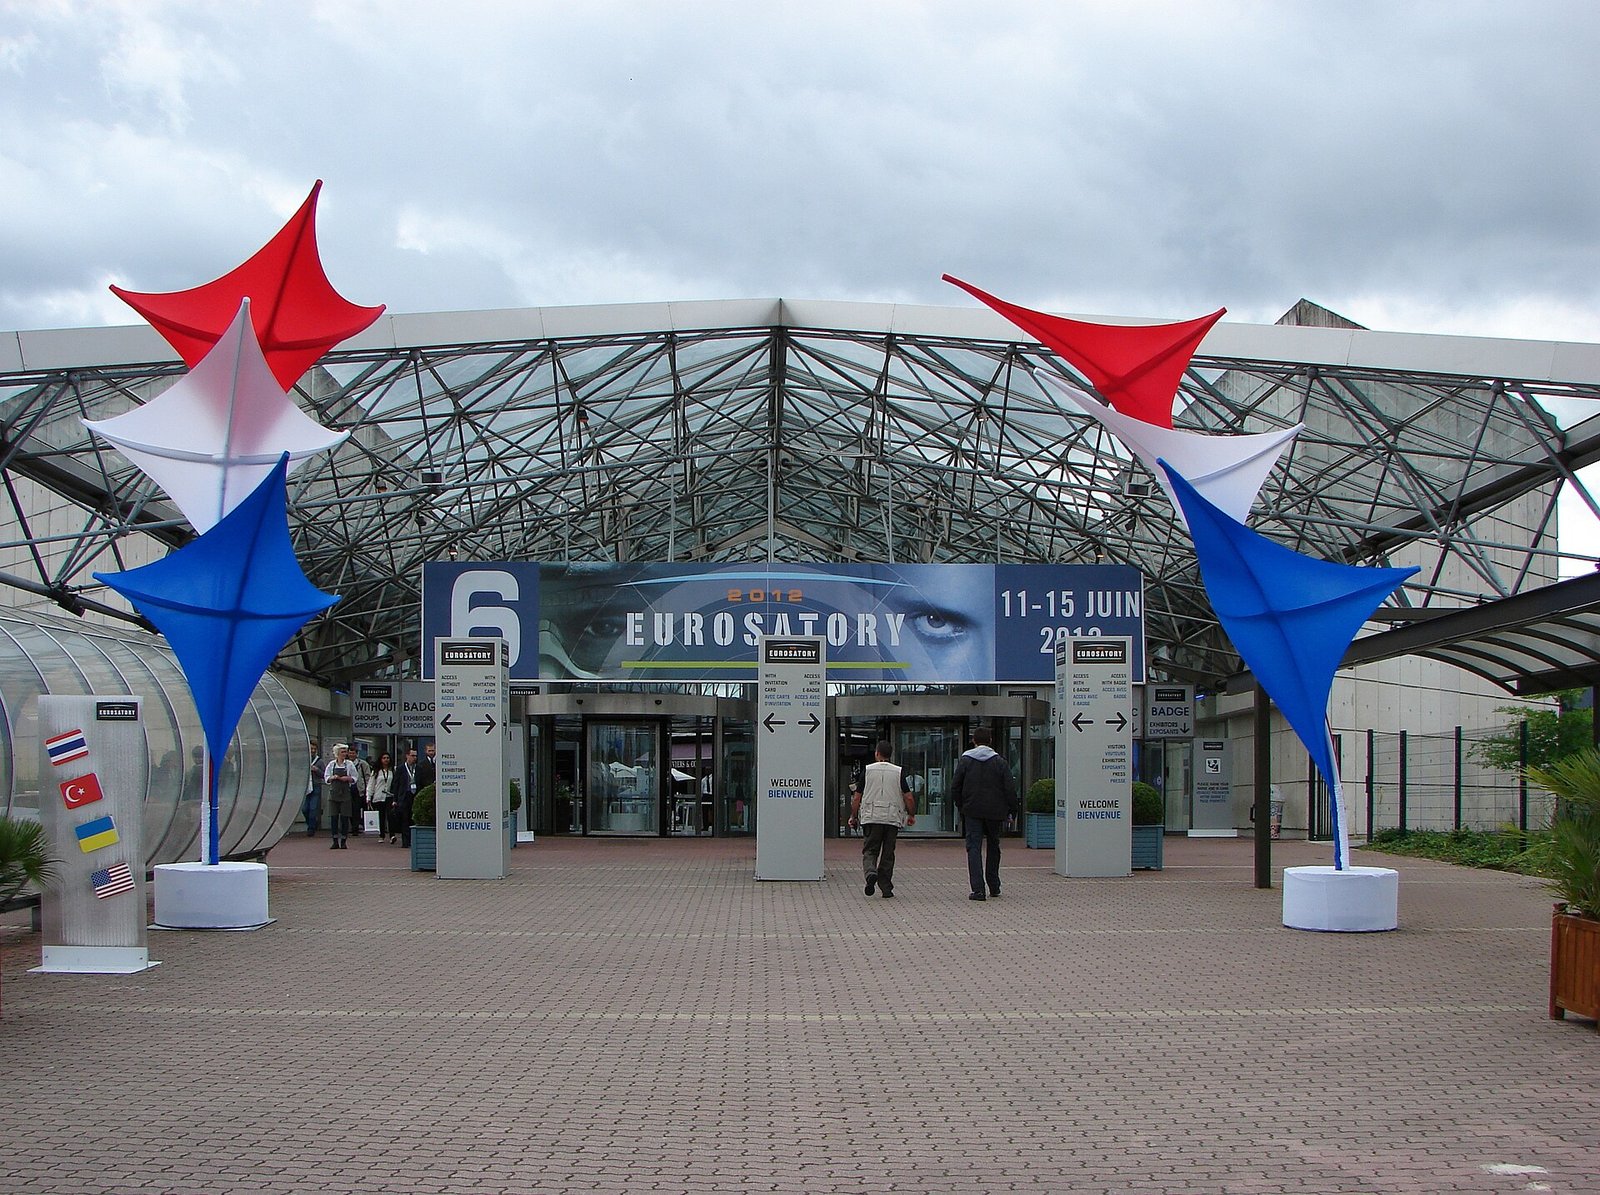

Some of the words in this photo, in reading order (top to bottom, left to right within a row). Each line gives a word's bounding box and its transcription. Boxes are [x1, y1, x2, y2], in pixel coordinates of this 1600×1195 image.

[727, 589, 804, 602] 2012
[1002, 590, 1074, 618] 11-15
[1085, 590, 1140, 618] JUIN
[451, 570, 520, 668] 6
[626, 612, 906, 646] EUROSATORY
[354, 702, 397, 712] WITHOUT
[1152, 706, 1190, 716] BADGE
[771, 778, 811, 787] WELCOME
[768, 790, 814, 798] BIENVENUE
[1080, 800, 1119, 808] WELCOME
[448, 811, 489, 819] WELCOME
[1077, 811, 1121, 820] BIENVENUE
[446, 822, 492, 830] BIENVENUE
